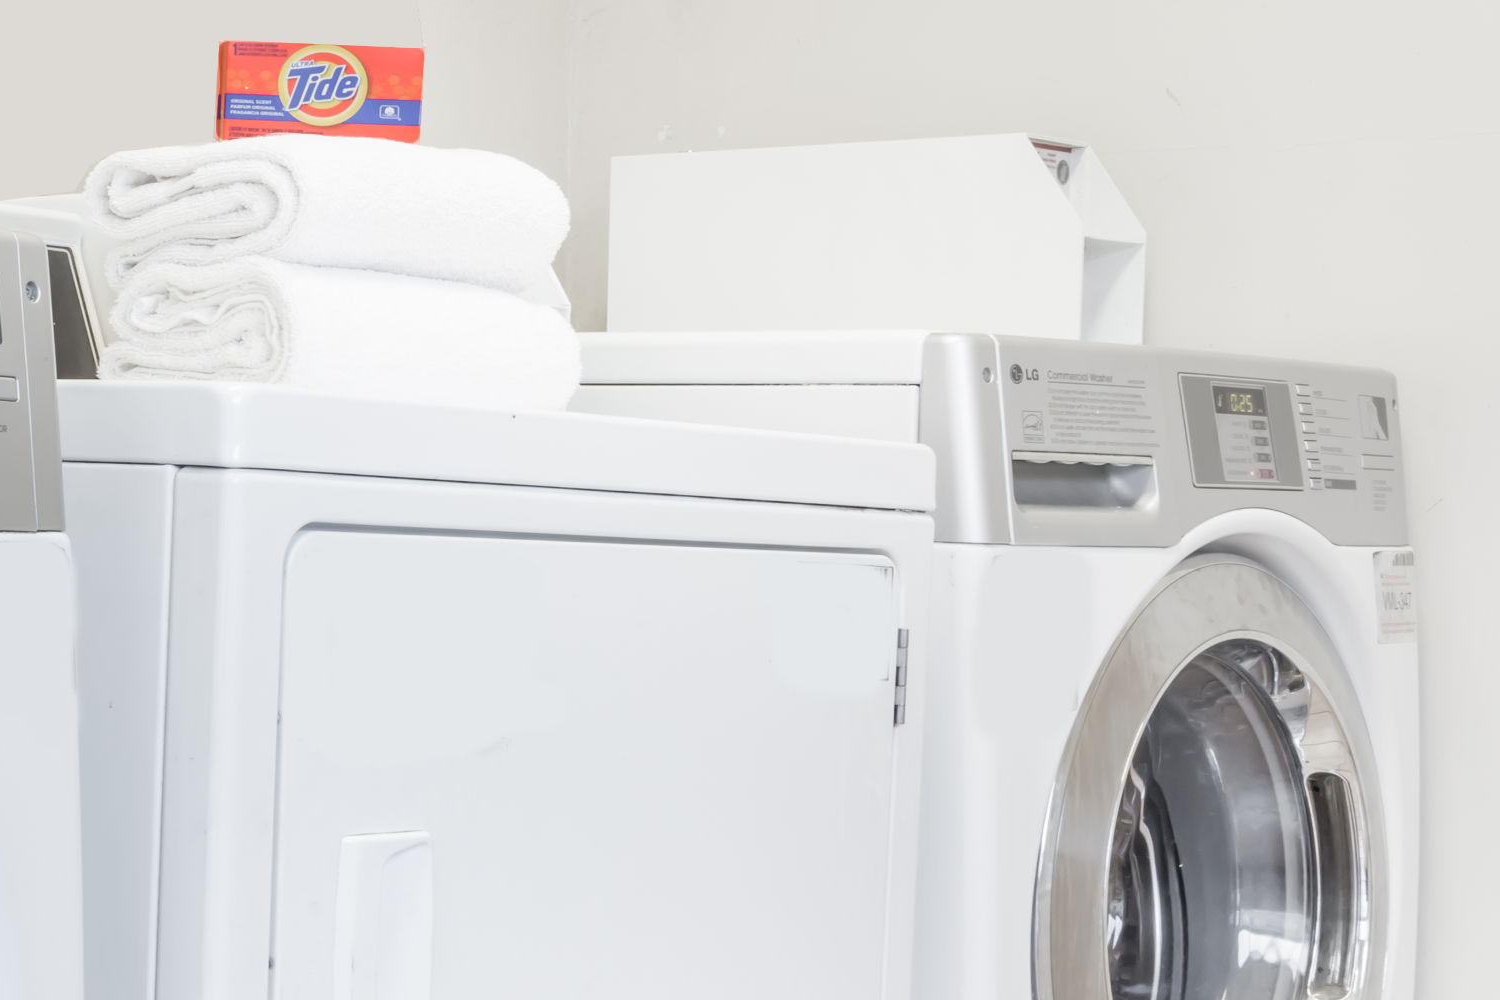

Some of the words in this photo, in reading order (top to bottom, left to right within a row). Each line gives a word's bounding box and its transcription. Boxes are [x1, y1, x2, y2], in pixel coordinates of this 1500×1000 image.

[291, 60, 314, 68] ULTRA
[286, 64, 360, 111] Tide
[1026, 368, 1040, 381] LG
[1230, 393, 1253, 413] 0:25
